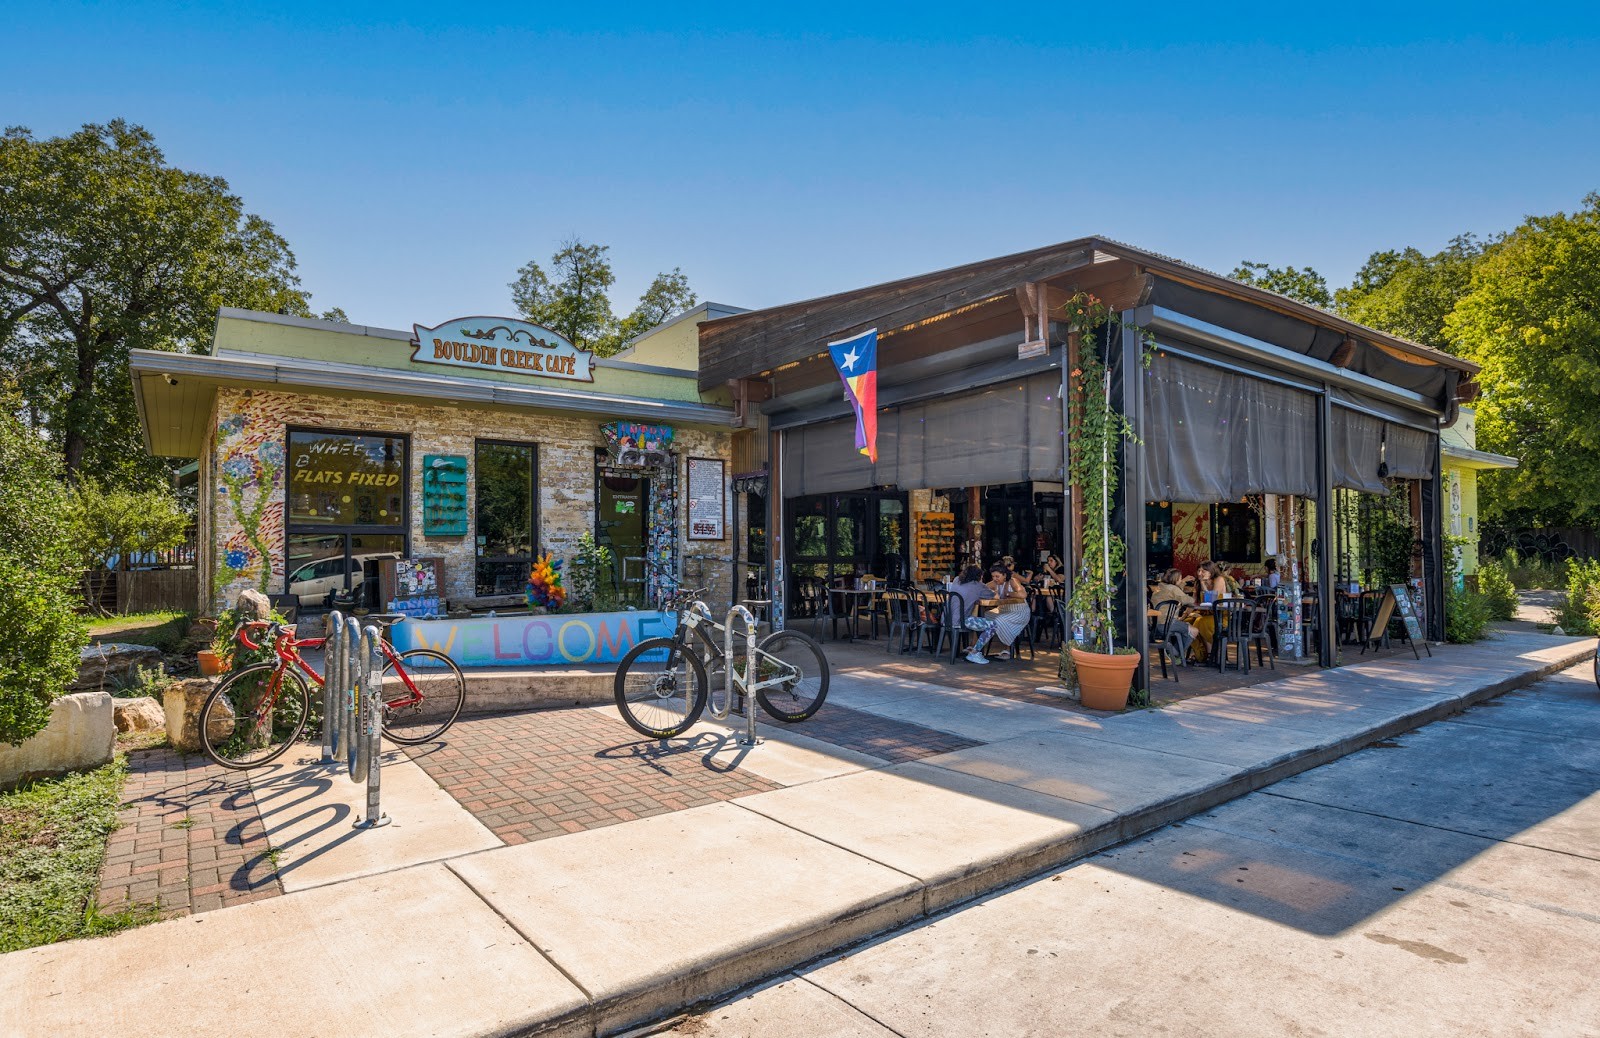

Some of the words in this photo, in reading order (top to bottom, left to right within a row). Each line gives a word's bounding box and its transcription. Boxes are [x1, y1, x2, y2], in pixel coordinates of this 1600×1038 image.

[433, 338, 498, 366] BOULDIN
[500, 347, 544, 371] CREEK
[545, 352, 576, 375] CAFÉ
[294, 469, 343, 484] FLATS
[347, 472, 400, 487] FIXED
[415, 617, 664, 662] WELCOME
